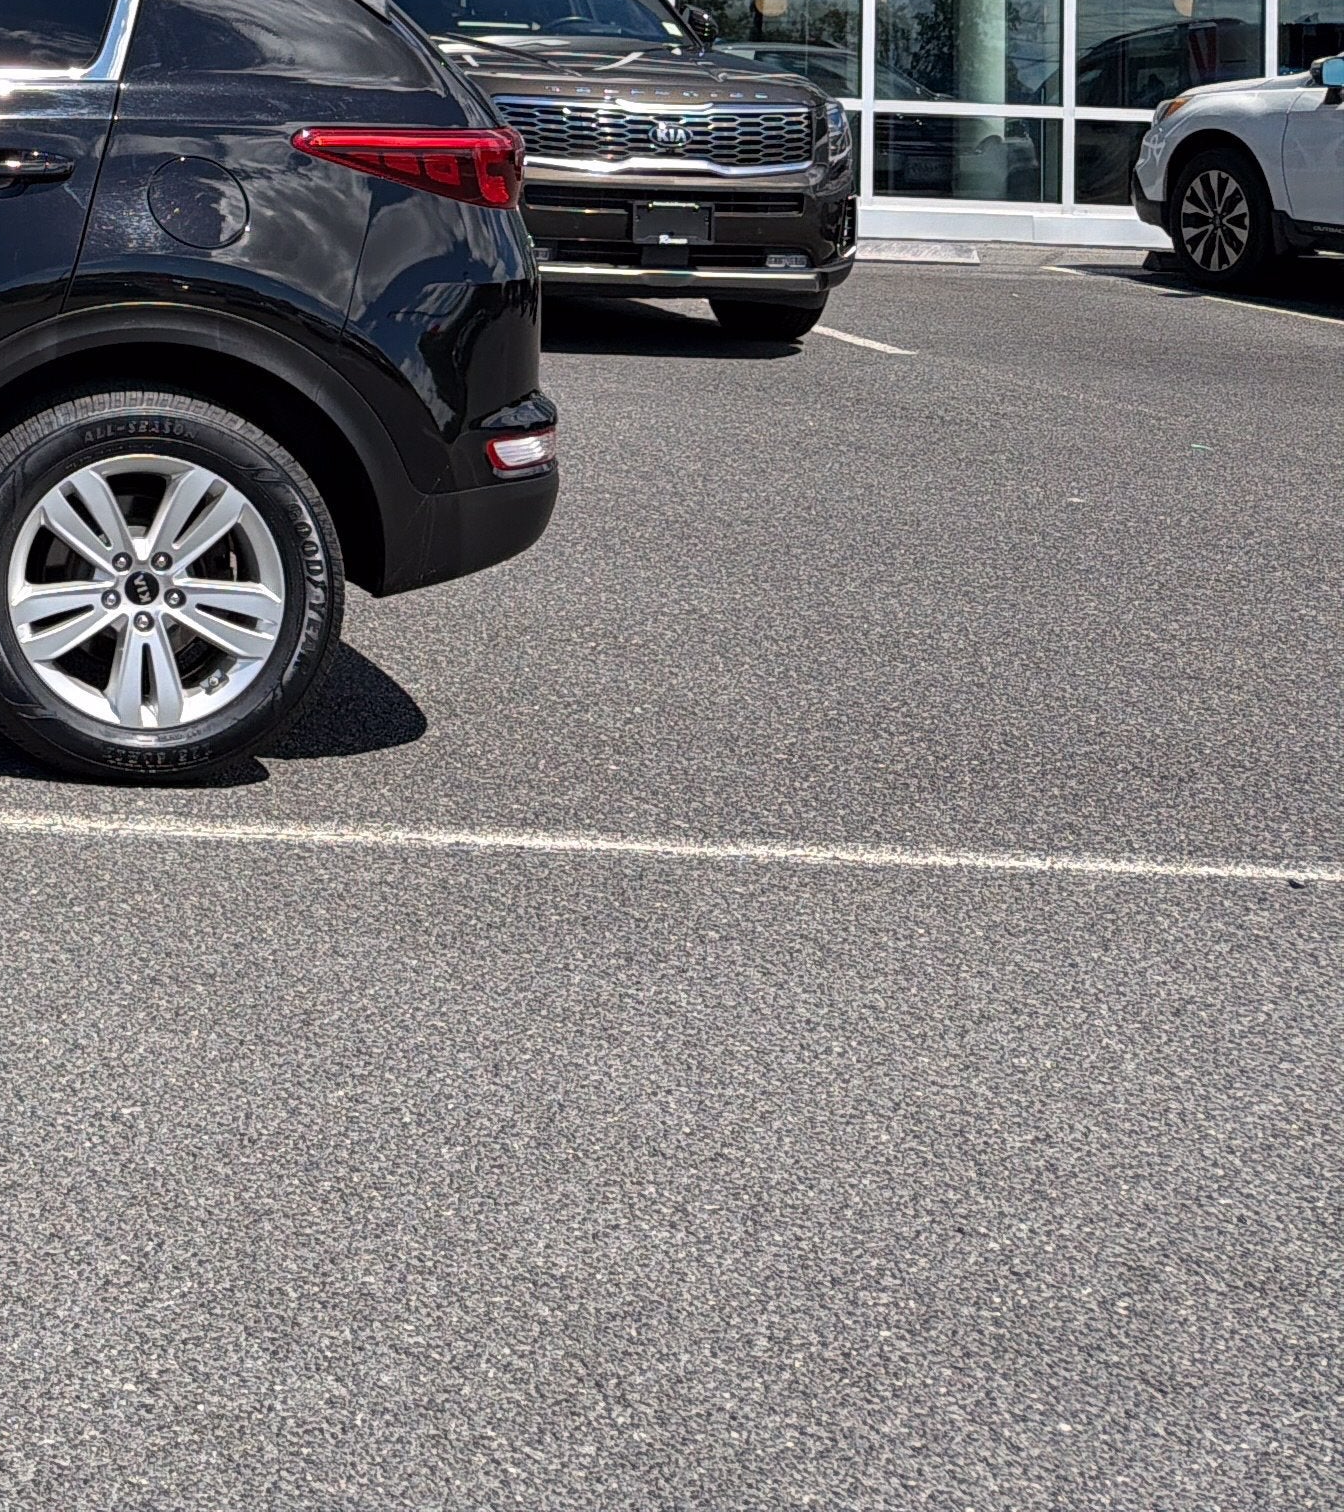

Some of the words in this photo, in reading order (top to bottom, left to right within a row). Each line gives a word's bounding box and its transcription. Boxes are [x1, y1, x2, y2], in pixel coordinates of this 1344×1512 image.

[656, 127, 687, 143] KIA
[83, 419, 199, 443] ALL-SEASON
[133, 574, 153, 603] KIA
[288, 502, 328, 669] GOODYEAR
